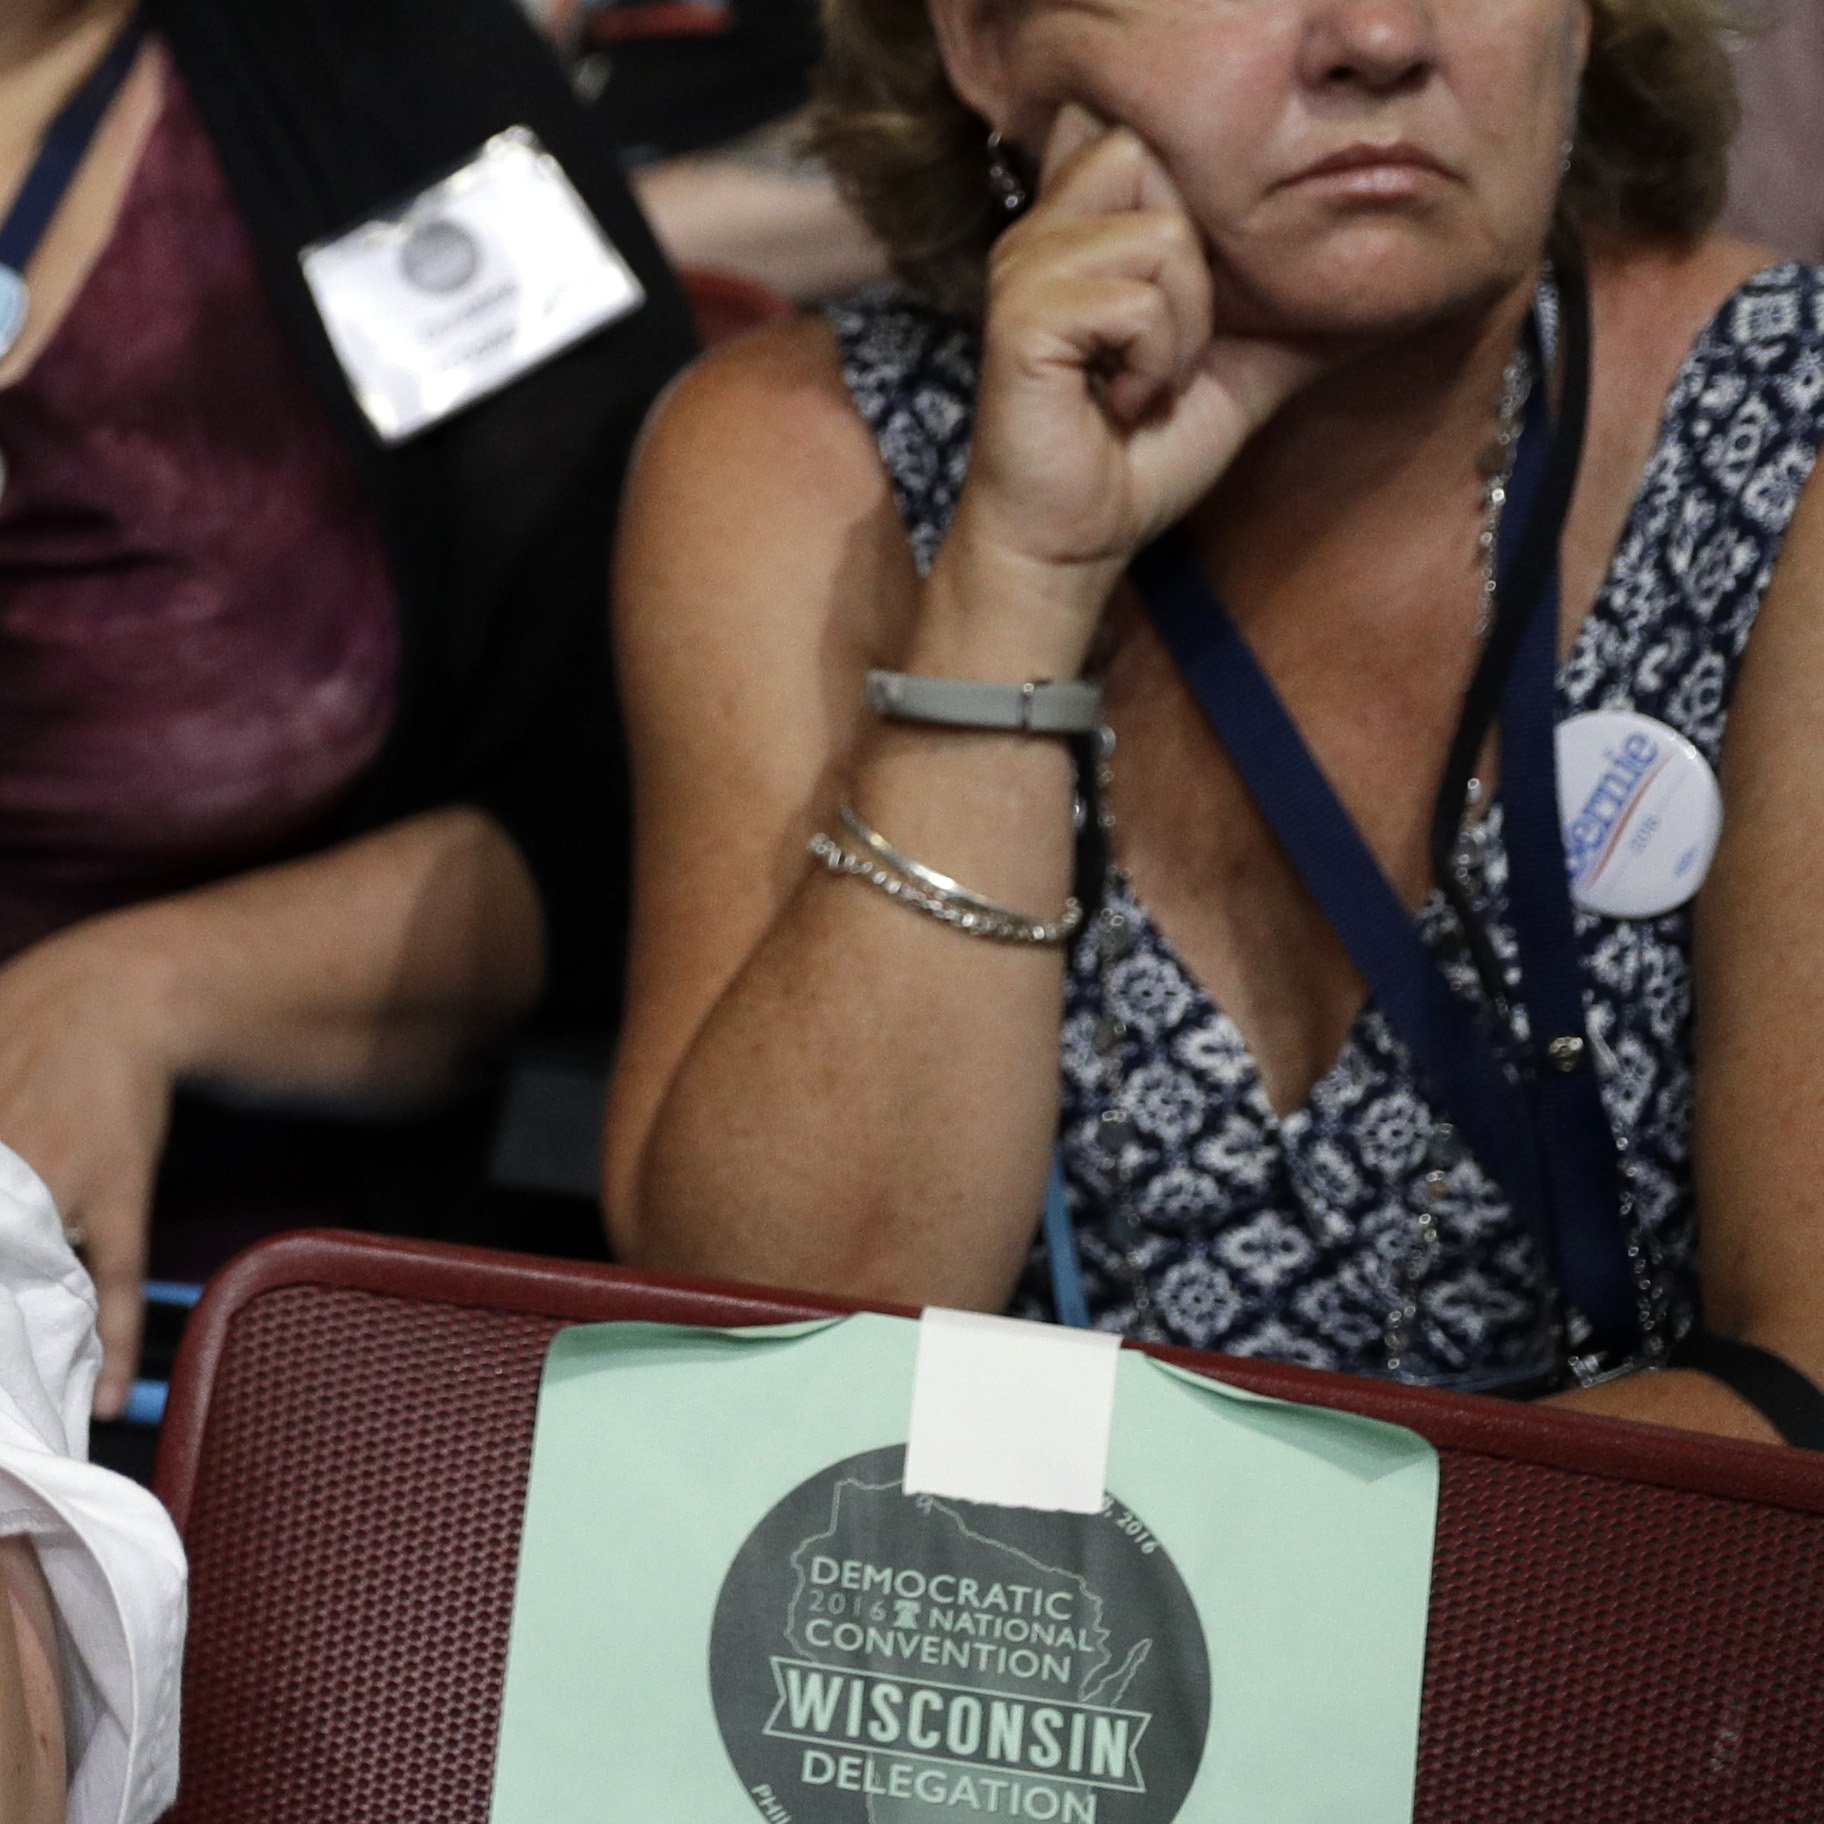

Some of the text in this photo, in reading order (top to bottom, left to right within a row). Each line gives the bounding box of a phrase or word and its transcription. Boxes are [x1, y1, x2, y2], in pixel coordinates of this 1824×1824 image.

[1567, 733, 1659, 880] ernie
[1115, 1511, 1160, 1555] 2016
[808, 1589, 1096, 1653] 2016 NATIONAL
[810, 1556, 1074, 1621] DEMOCRATIC
[804, 1618, 1071, 1684] CONVENTION
[787, 1668, 1129, 1778] WISCONSIN
[801, 1749, 1098, 1824] DELEGATION
